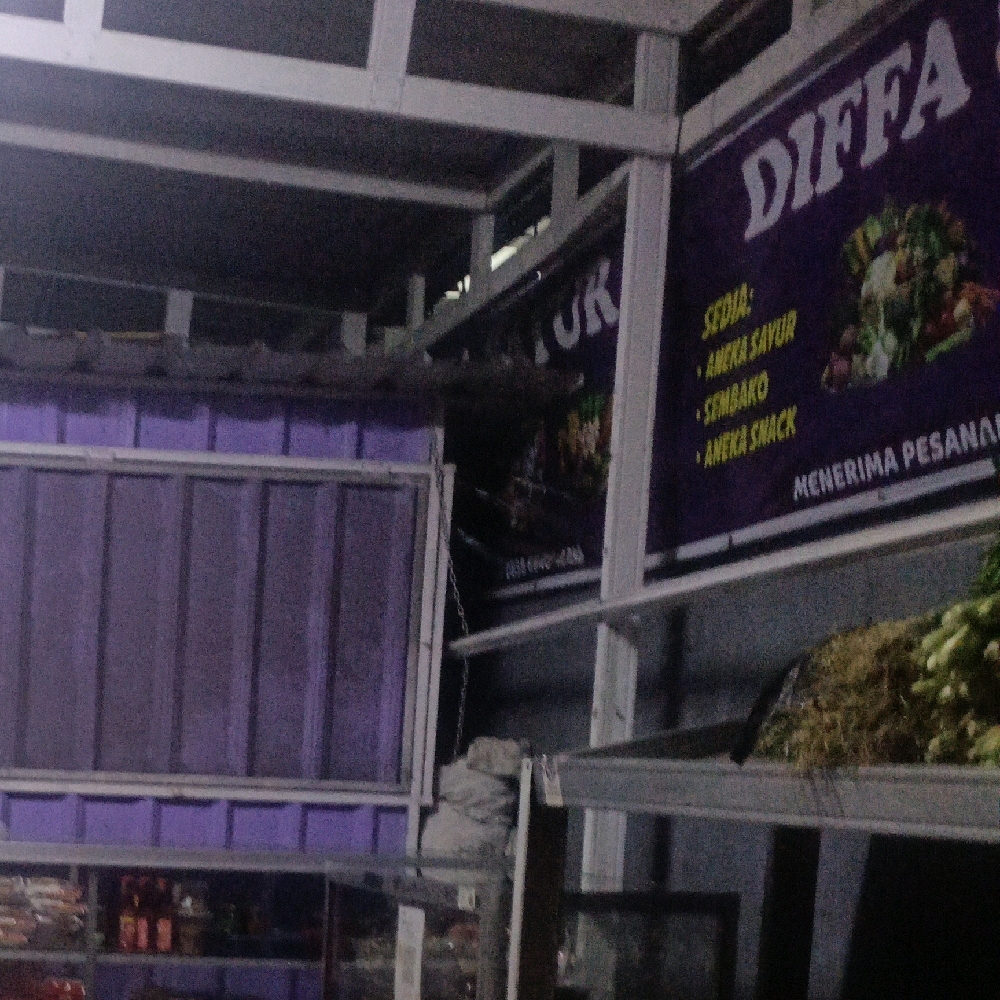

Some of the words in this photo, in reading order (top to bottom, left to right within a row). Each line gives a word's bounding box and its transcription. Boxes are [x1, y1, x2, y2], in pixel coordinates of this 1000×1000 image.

[741, 18, 970, 242] DIFFA
[750, 309, 797, 361] SAYUR
[704, 370, 769, 426] SEMBAKO
[704, 425, 749, 469] ANEKA
[749, 405, 797, 452] SNACK
[794, 447, 899, 500] MENERIMA
